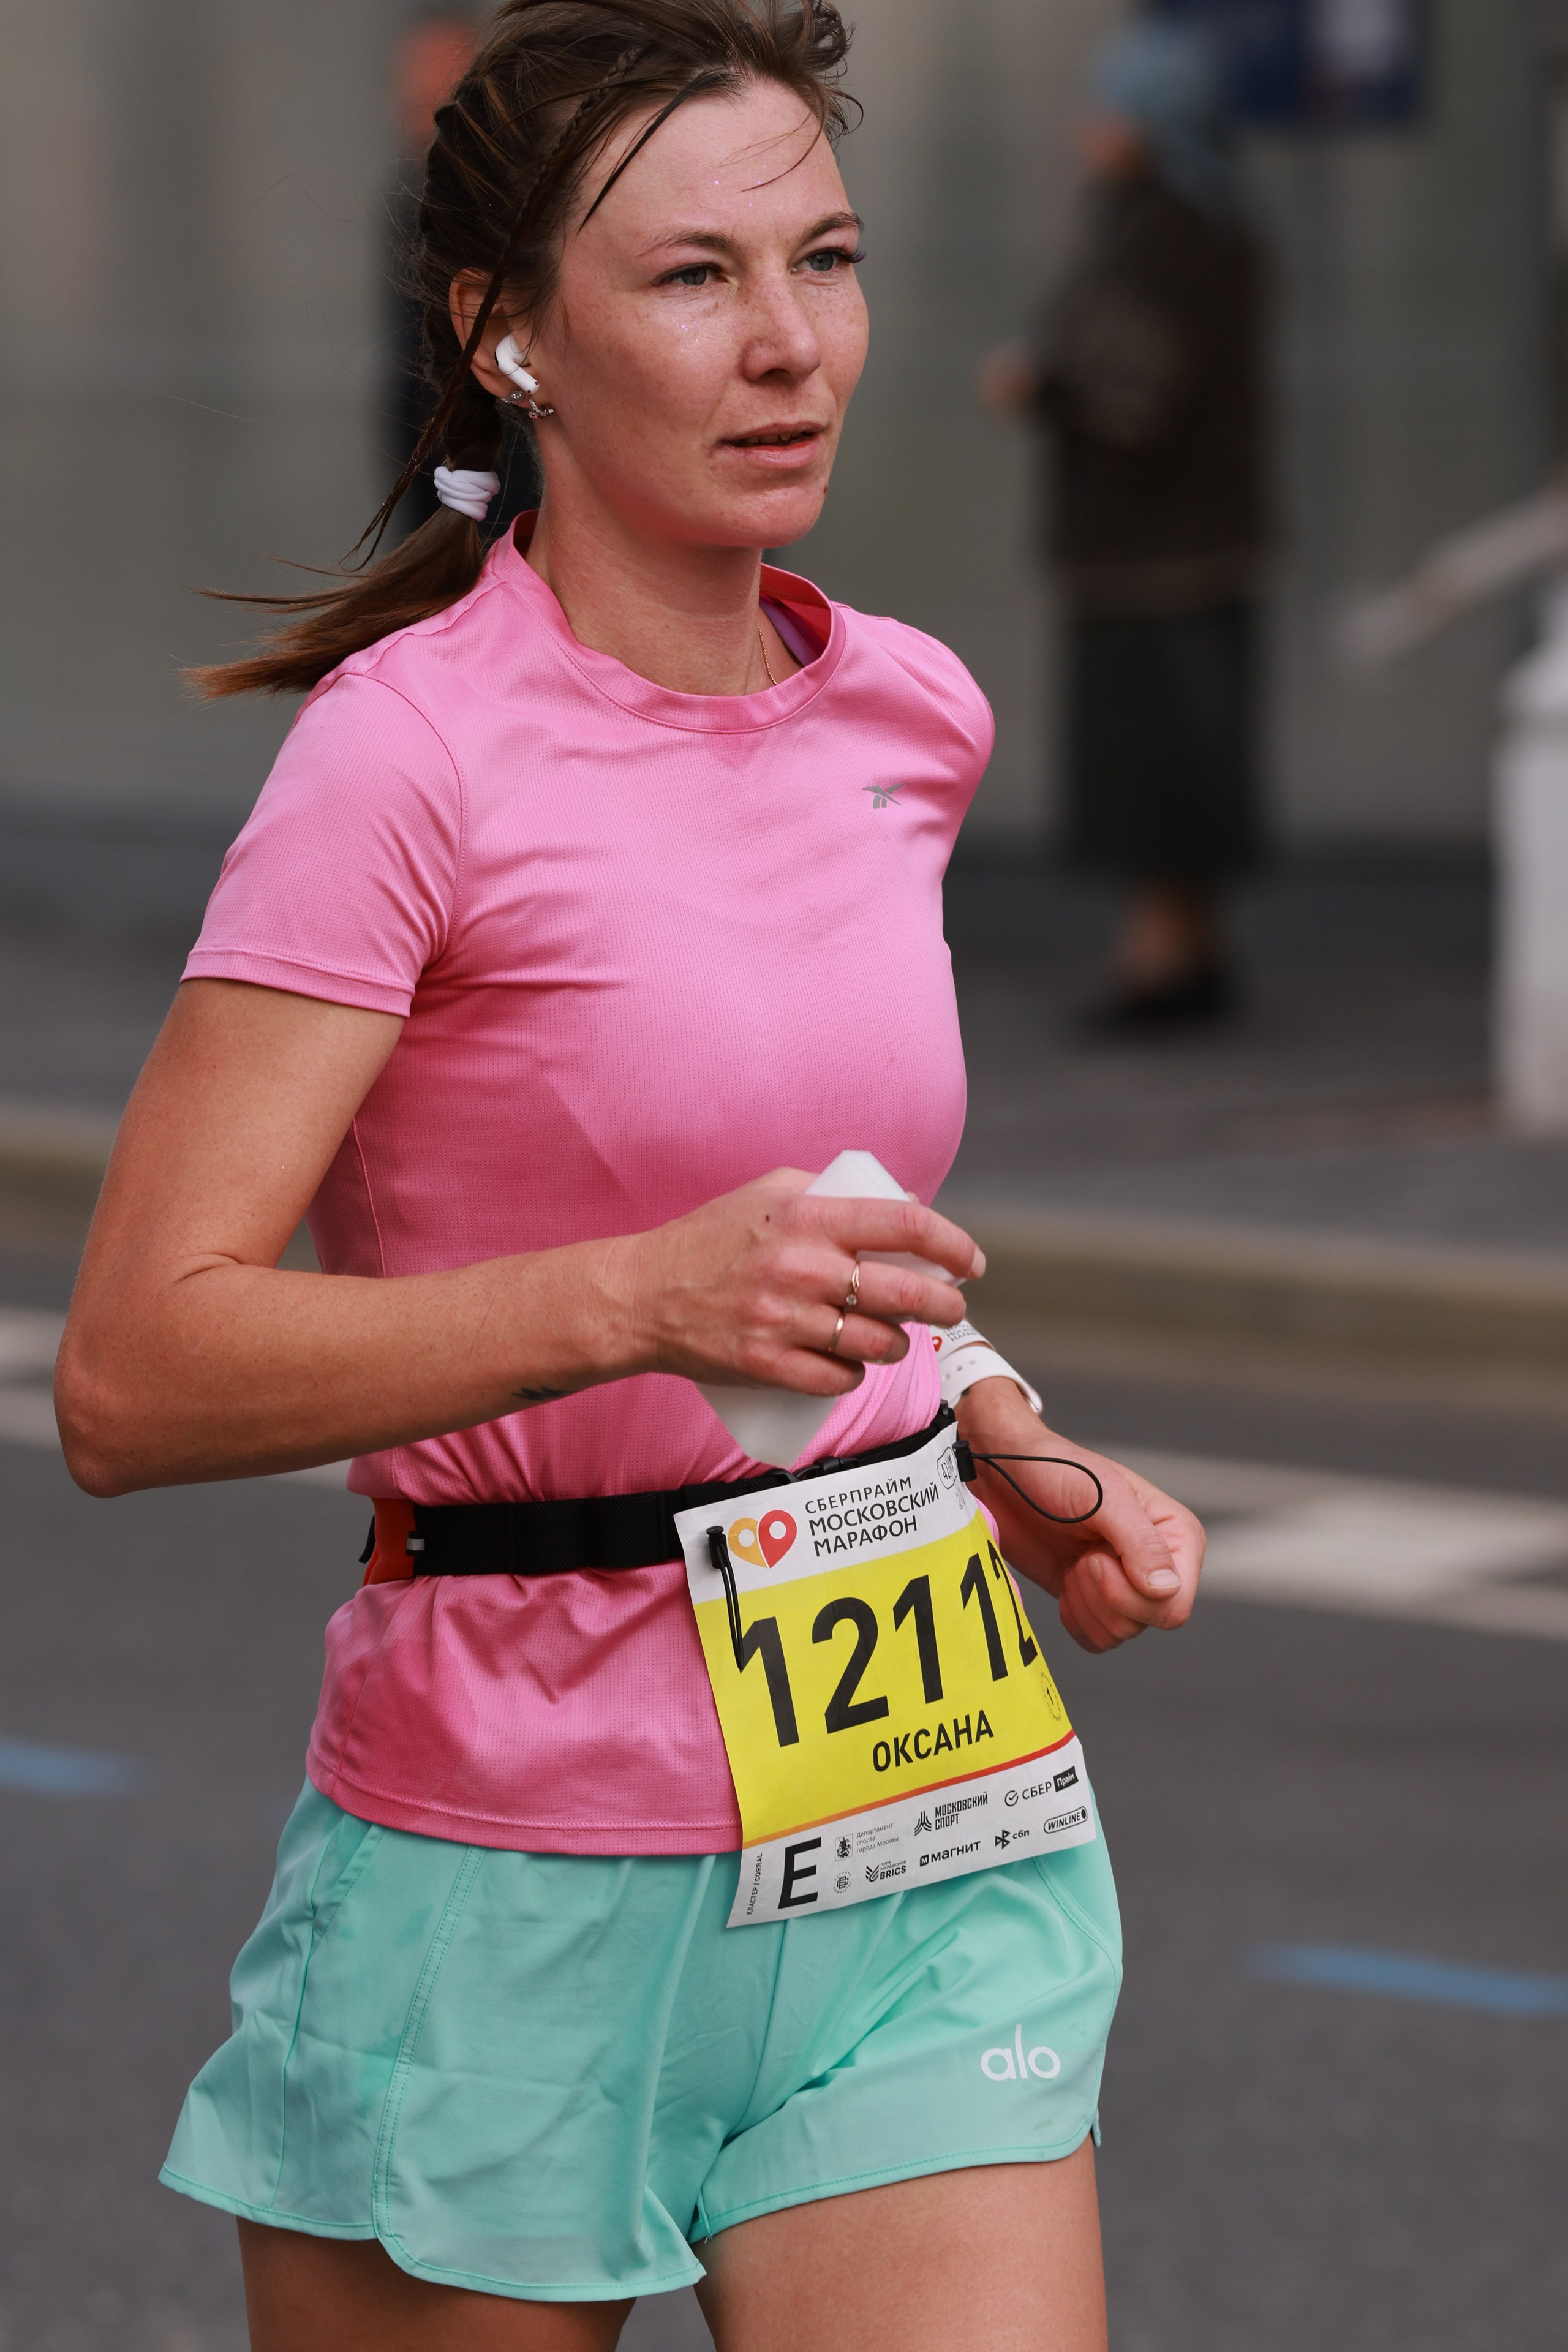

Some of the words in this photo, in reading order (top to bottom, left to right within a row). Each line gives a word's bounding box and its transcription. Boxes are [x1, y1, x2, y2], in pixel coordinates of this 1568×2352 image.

[805, 1477, 911, 1514] СБЕРПРАЙМ
[809, 1482, 939, 1536] МОСКОВСКИЙ
[813, 1515, 917, 1557] МАРАФОН
[740, 1539, 1038, 1747] 12112
[873, 1709, 995, 1772] ОКСАНА
[1022, 1781, 1052, 1800] СБЕР
[1057, 1773, 1075, 1787] Прайм
[935, 1791, 988, 1818] МОСКОВСКИЙ
[856, 1823, 894, 1839] Департамент
[935, 1813, 960, 1830] СПОРТ
[1012, 1830, 1030, 1839] сбп
[1048, 1812, 1080, 1831] WINLINE
[856, 1836, 876, 1845] спорта
[856, 1844, 876, 1853] города
[877, 1836, 899, 1847] Москвы
[931, 1841, 981, 1862] магнит
[746, 1887, 758, 1915] КЛАСТЕР
[754, 1852, 763, 1882] CORRAL
[880, 1865, 907, 1880] BRICS
[980, 2023, 1061, 2081] alo
